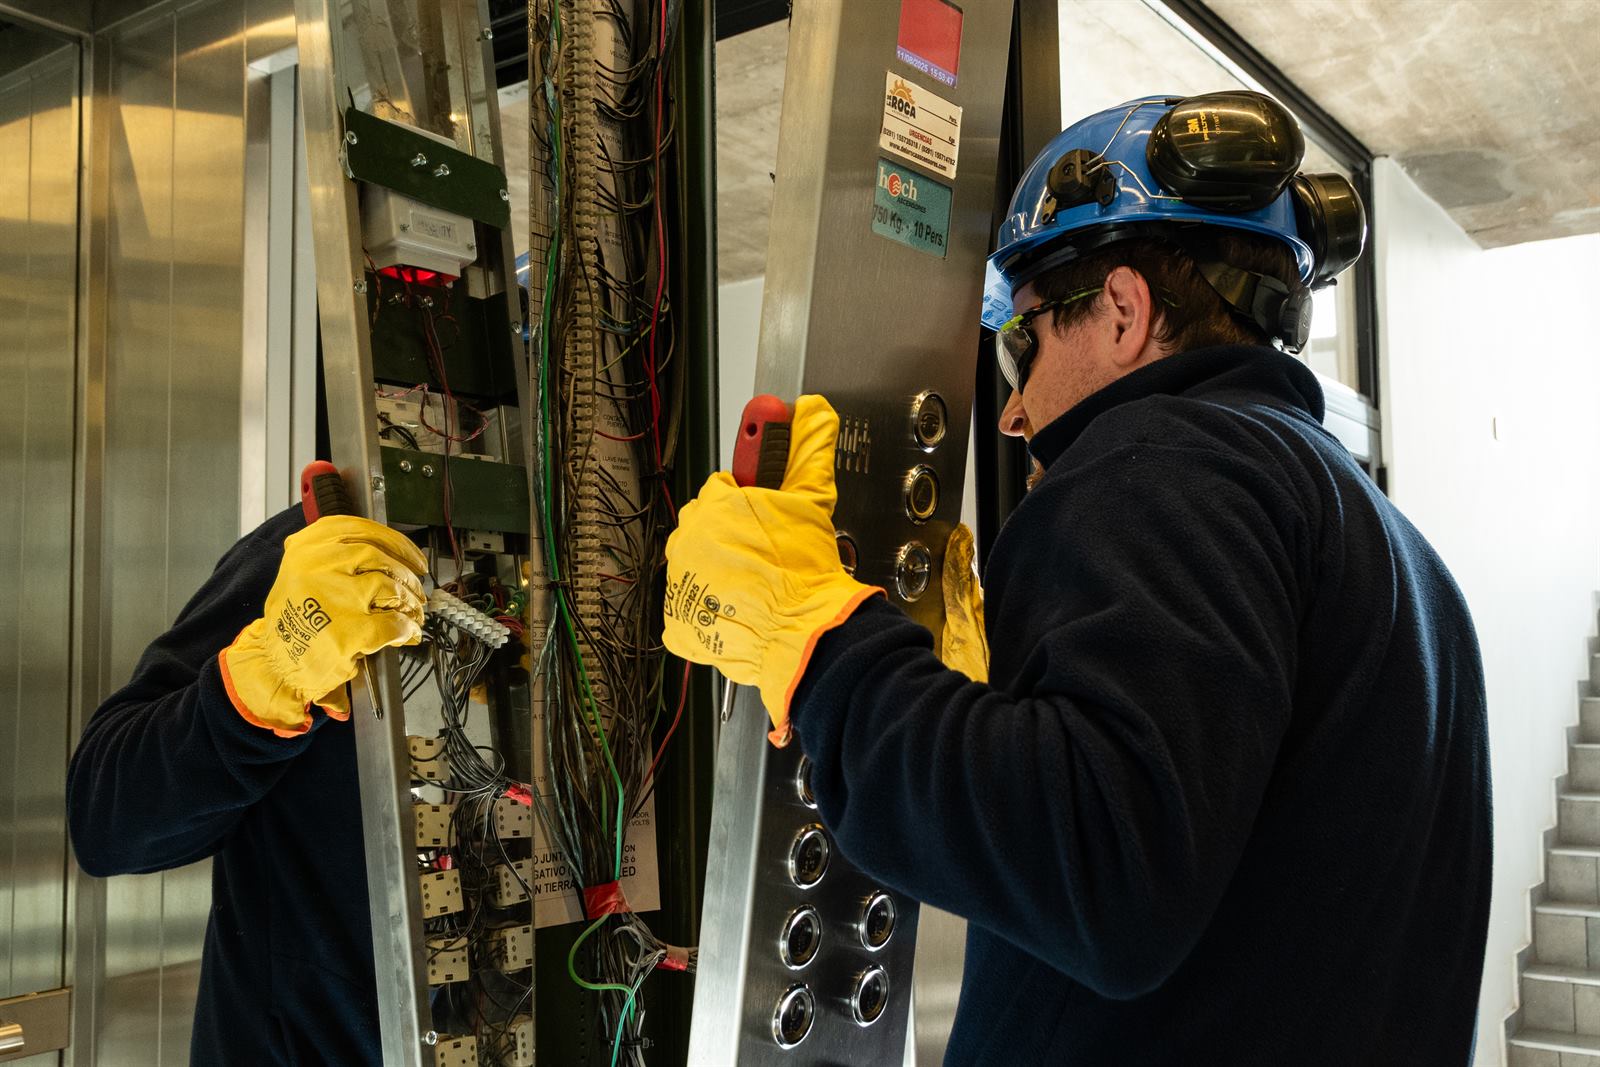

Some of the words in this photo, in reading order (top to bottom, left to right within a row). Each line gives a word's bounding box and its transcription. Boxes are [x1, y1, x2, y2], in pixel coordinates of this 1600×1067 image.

[897, 50, 929, 72] 11/08/2025
[930, 67, 955, 86] 15:53:47
[891, 95, 916, 119] ROCA
[1187, 118, 1200, 134] 3M
[908, 128, 933, 146] URGENCIAS
[872, 204, 888, 225] 750
[914, 220, 924, 239] 10
[924, 223, 945, 247] Pers.
[540, 851, 566, 864] JUNT
